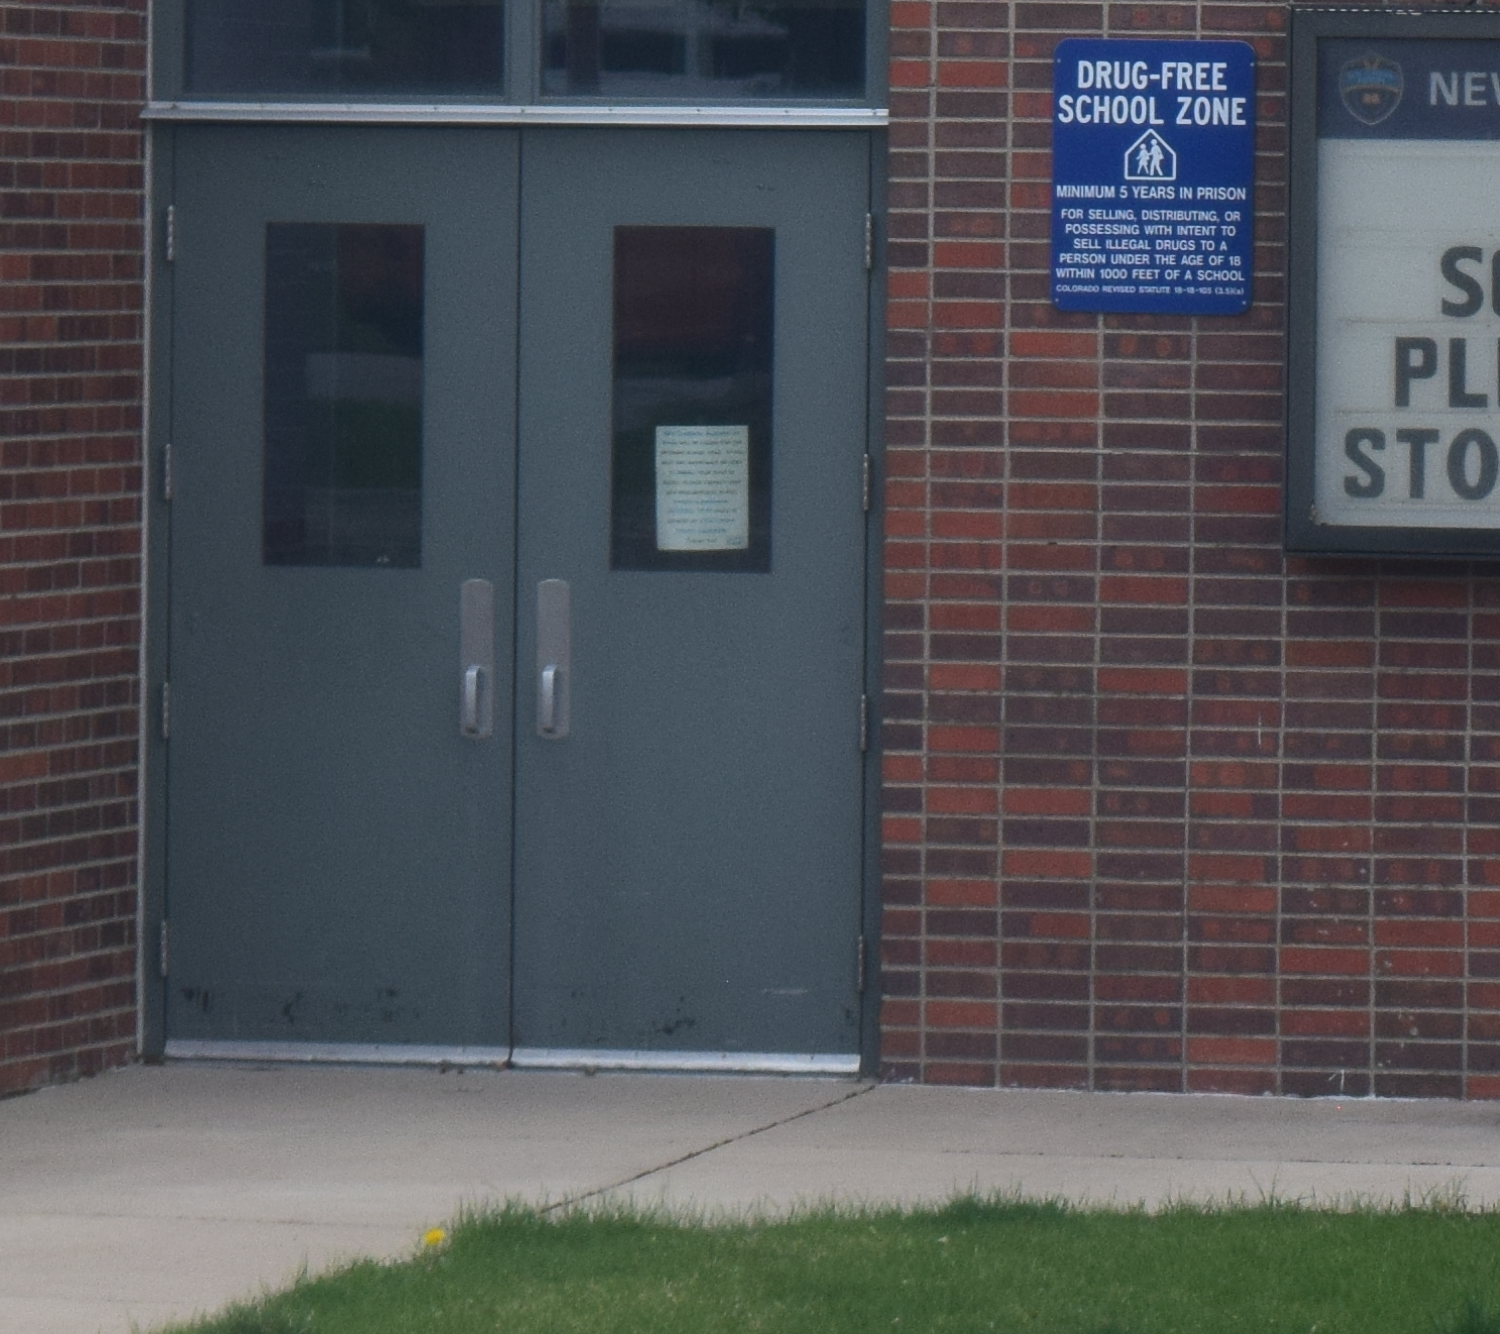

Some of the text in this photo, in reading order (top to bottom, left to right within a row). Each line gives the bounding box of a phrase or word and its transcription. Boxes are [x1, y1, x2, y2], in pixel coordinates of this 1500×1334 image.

[1077, 61, 1228, 91] DRUG-FREE
[1058, 96, 1246, 125] SCHOOL ZONE
[1057, 185, 1246, 200] MINIMUM 5 YEARS IN PRISON
[1061, 209, 1240, 222] FOR SELLING, DISTRIBUTING, OR
[1065, 224, 1235, 237] POSSESSING WITH INTENT TO
[1074, 239, 1228, 251] SELL ILLEGAL DRUGS TO A
[1060, 253, 1241, 266] PERSON UNDER THE AGE OF 18
[1056, 268, 1245, 281] WITHIN 1000 FEET OF A SCHOOL
[1056, 285, 1099, 293] COLORADO
[1102, 285, 1136, 293] REVISED
[1138, 286, 1171, 294] STATUTE
